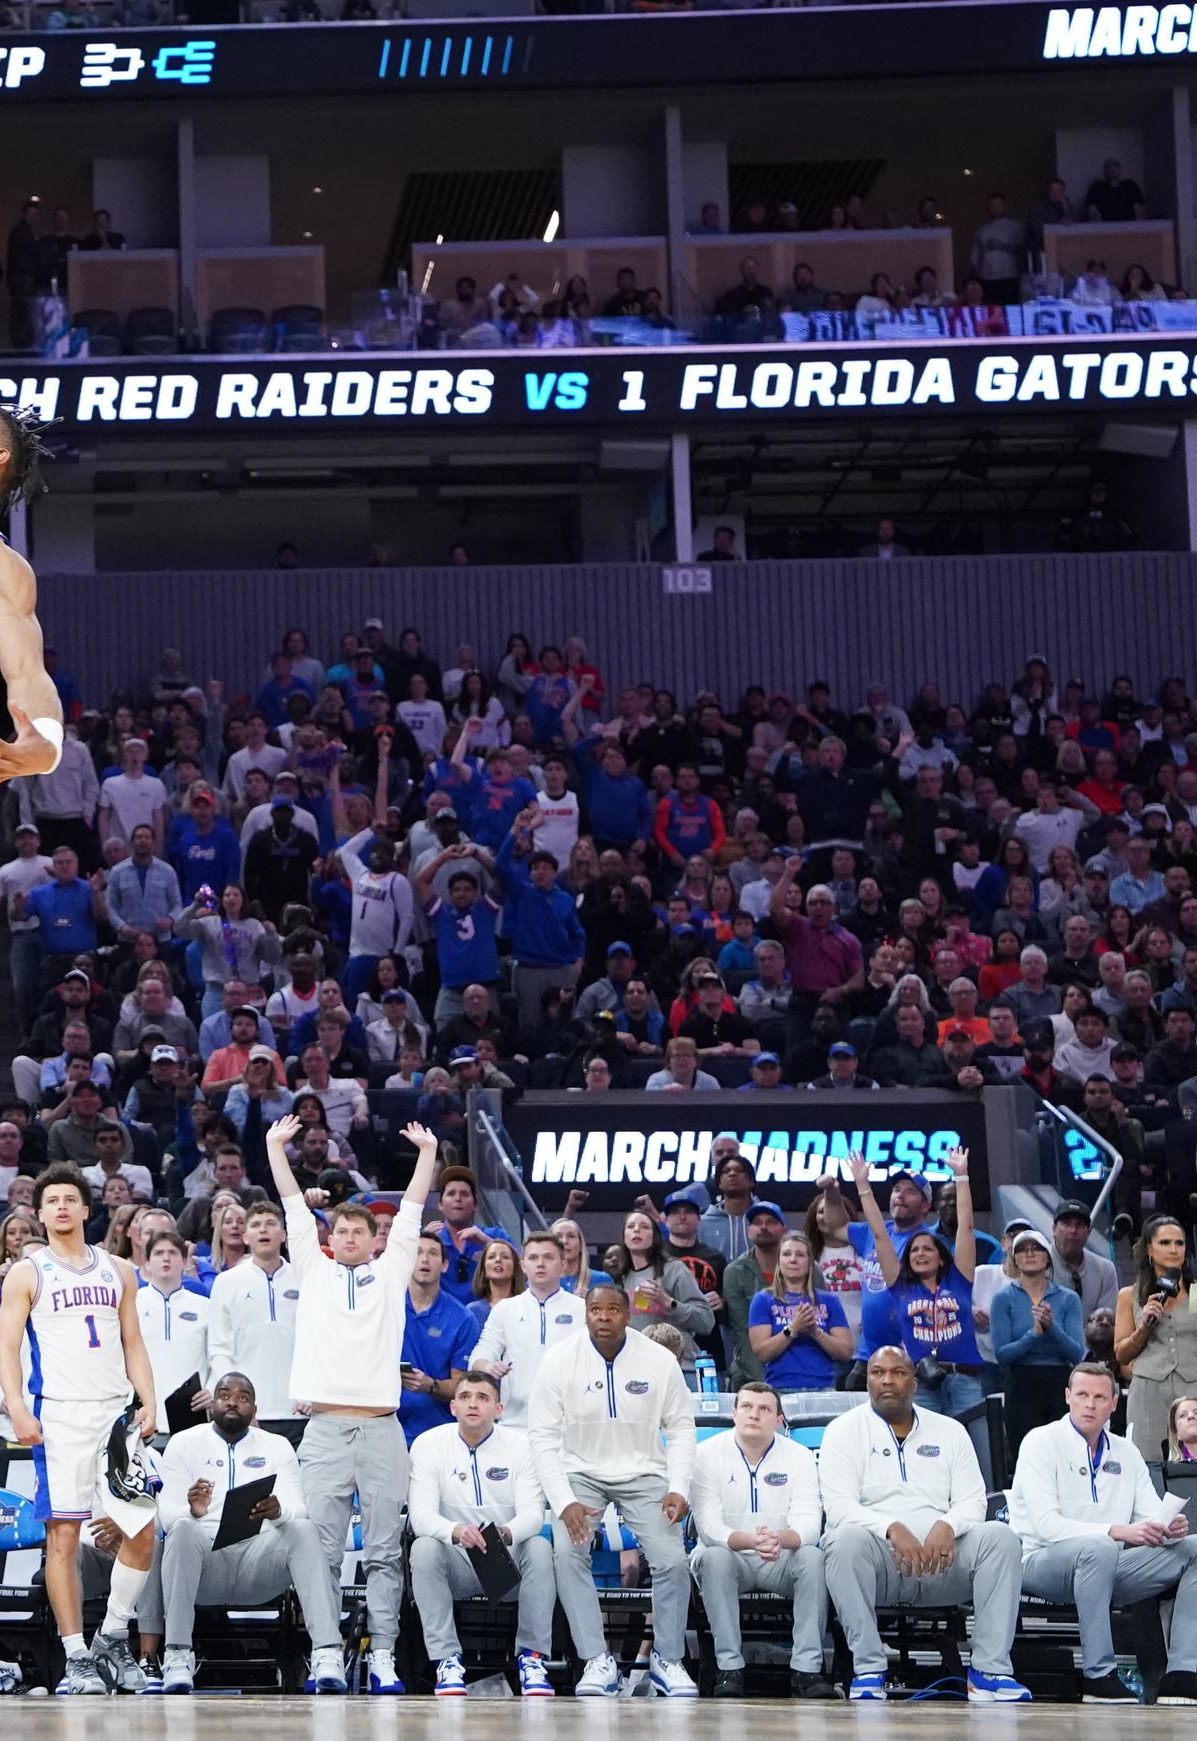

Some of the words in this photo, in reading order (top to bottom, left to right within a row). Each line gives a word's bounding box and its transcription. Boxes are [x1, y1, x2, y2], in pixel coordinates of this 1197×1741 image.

[76, 374, 199, 421] RED
[215, 369, 495, 419] RAIDERS
[524, 372, 589, 411] VS
[617, 370, 646, 411] 1
[679, 358, 955, 410] FLORIDA
[664, 569, 712, 592] 103
[456, 915, 476, 941] 3
[531, 1130, 713, 1182] MARCH
[51, 1286, 117, 1312] FLORIDA
[84, 1314, 101, 1349] 1
